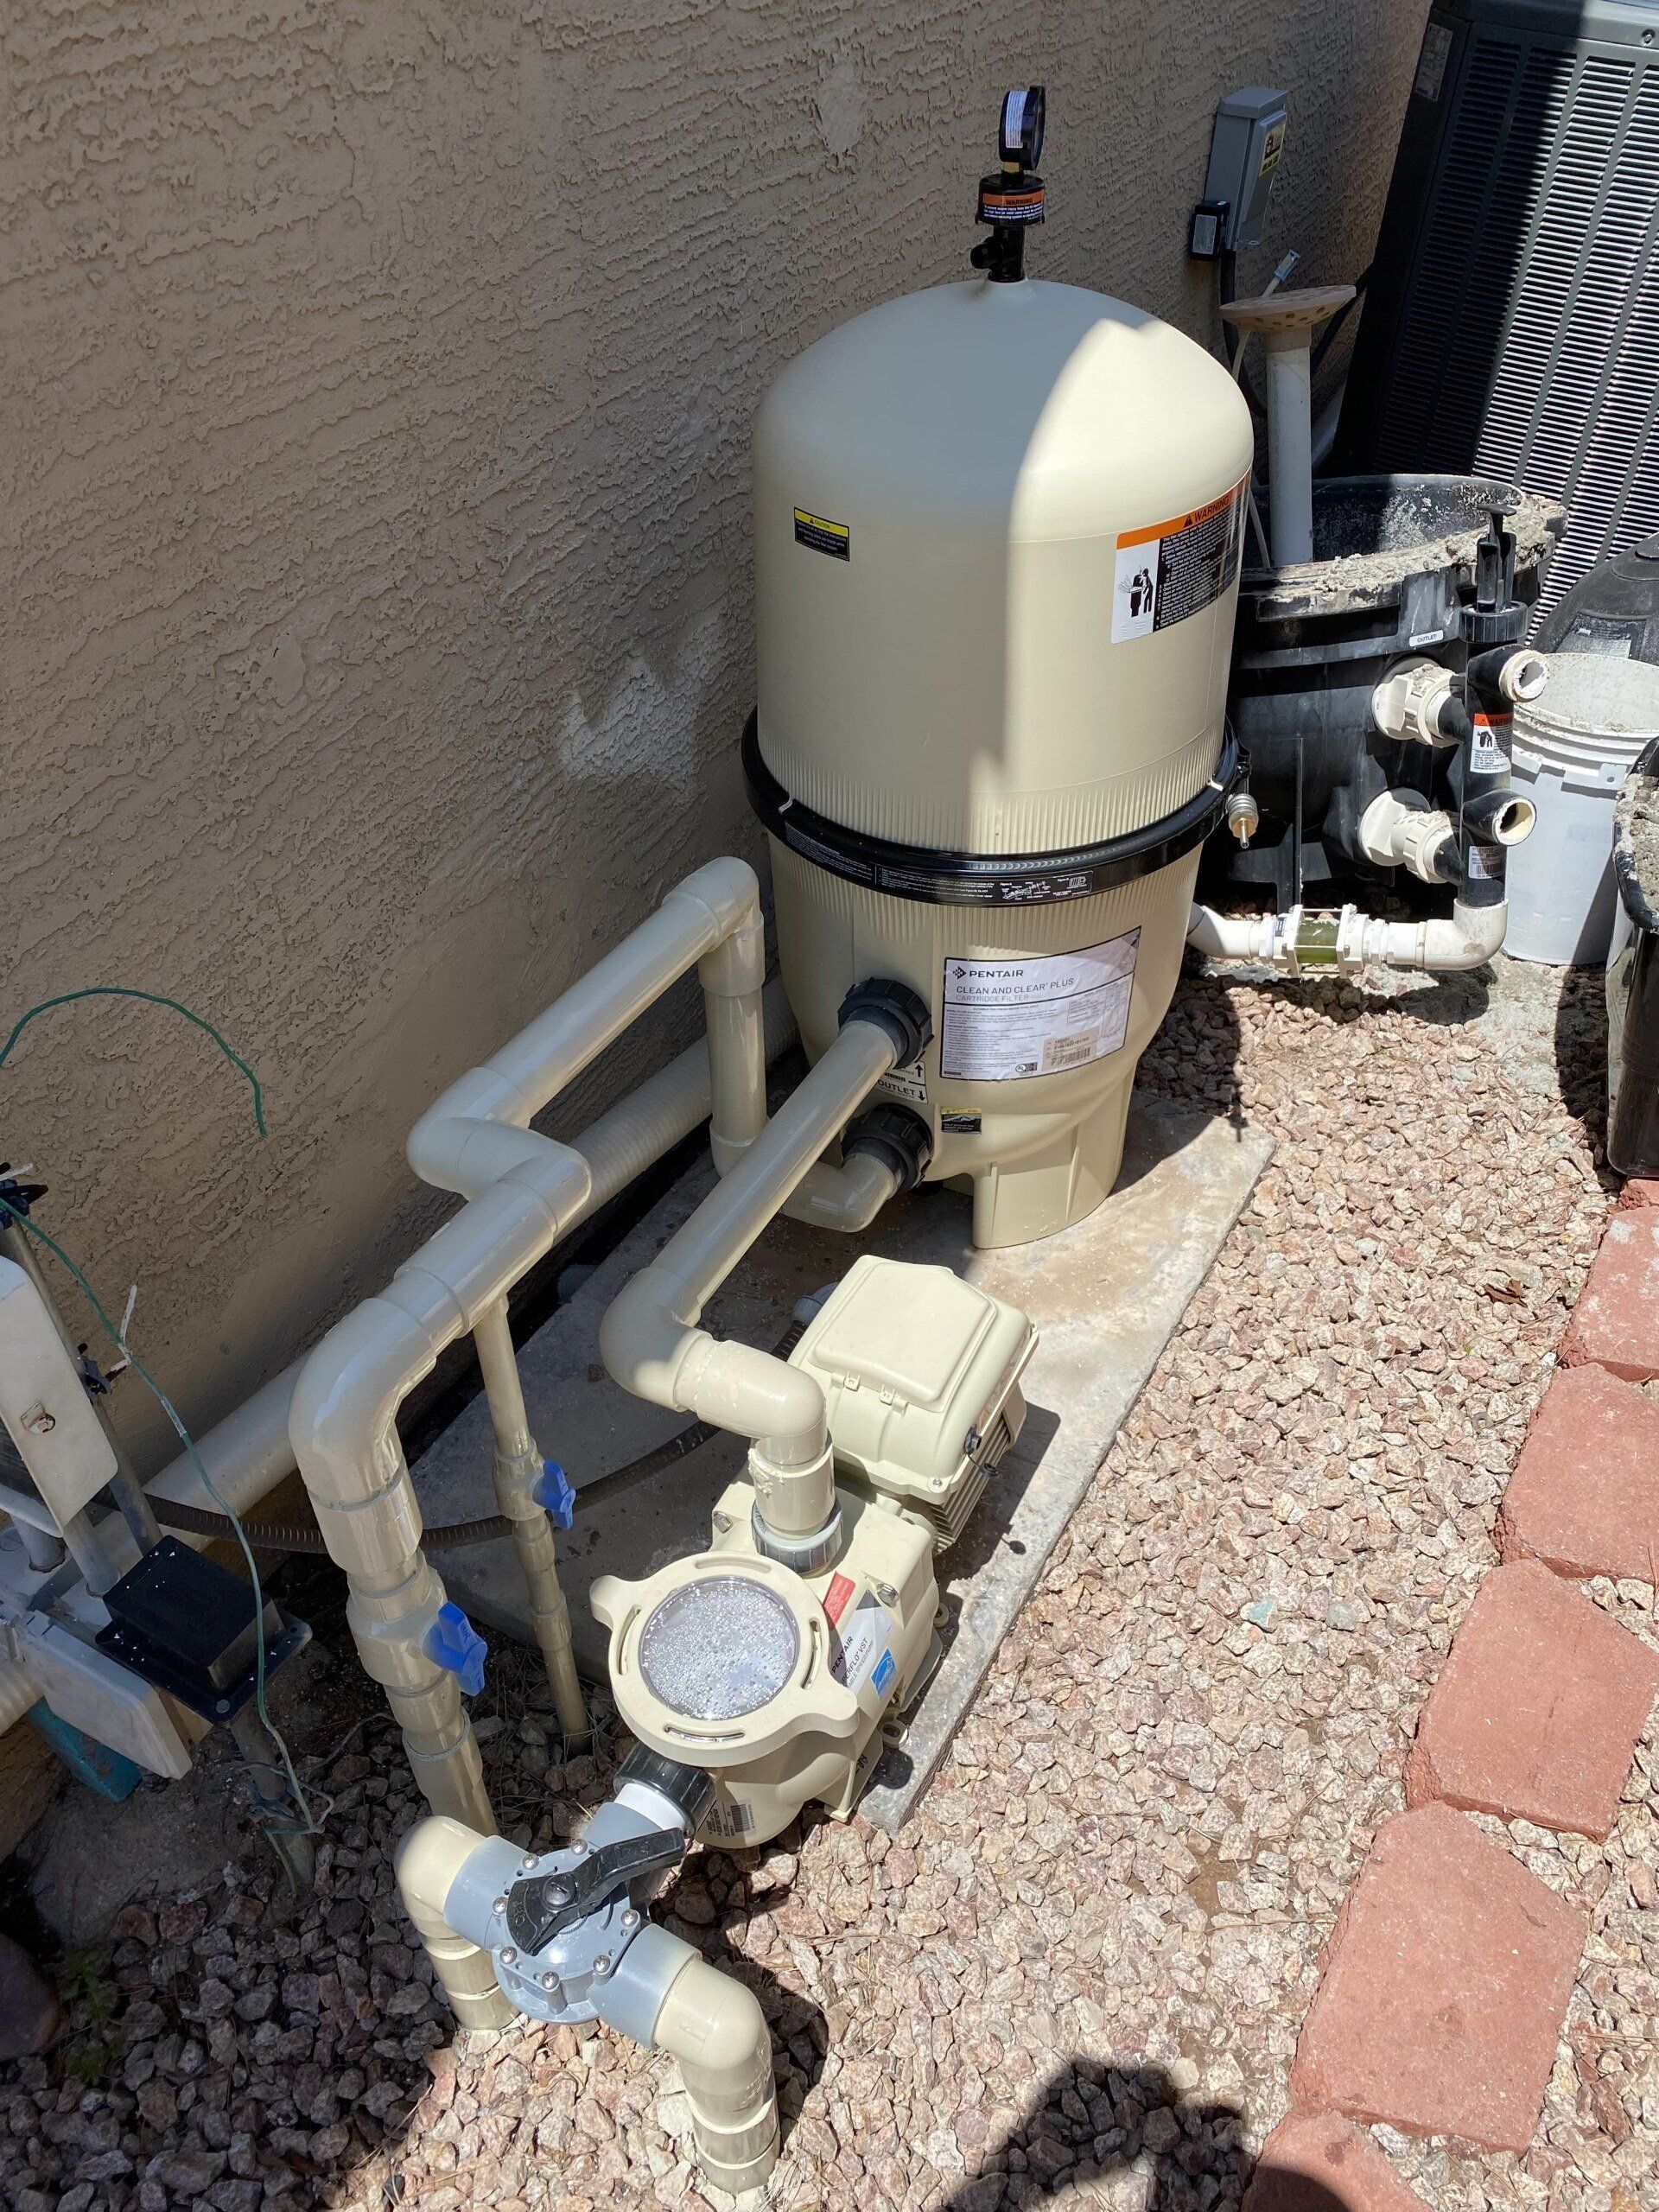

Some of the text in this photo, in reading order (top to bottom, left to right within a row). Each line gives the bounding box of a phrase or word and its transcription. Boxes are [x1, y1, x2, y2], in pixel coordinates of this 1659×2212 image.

[1194, 496, 1229, 522] WARNING
[1417, 634, 1438, 643] OUTLET
[969, 969, 1024, 978] PENTAIR
[957, 986, 989, 995] CLEAN
[1050, 977, 1074, 989] PLUS
[1001, 994, 1029, 1002] FILTER
[877, 1079, 916, 1096] OUTLET
[831, 1636, 854, 1674] PENTAIR
[841, 1637, 868, 1685] PERFLO VST
[848, 1674, 857, 1688] ABLE
